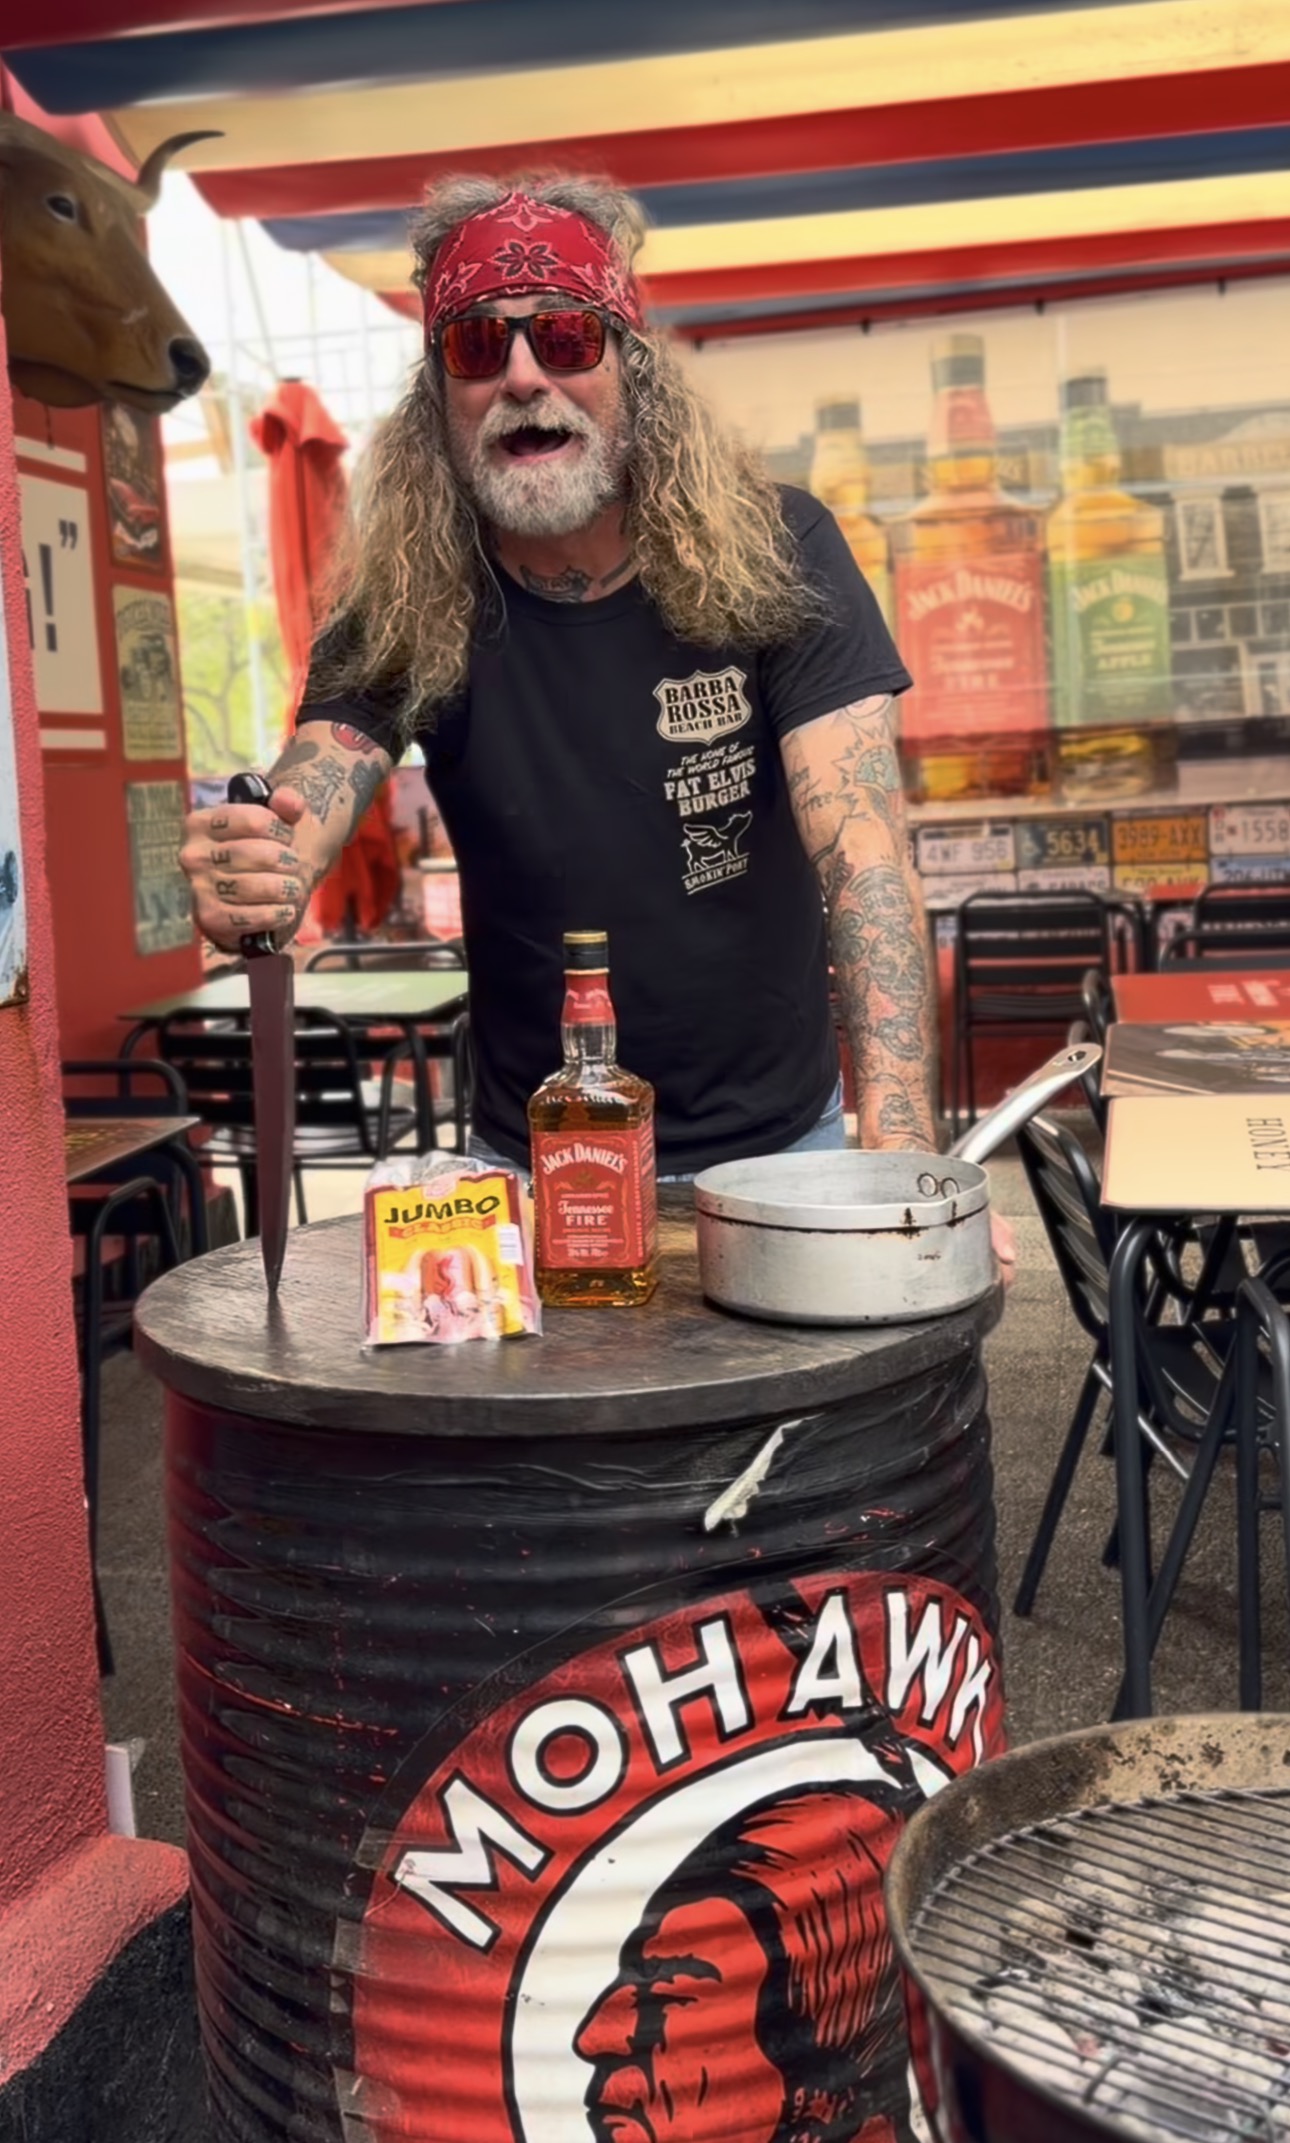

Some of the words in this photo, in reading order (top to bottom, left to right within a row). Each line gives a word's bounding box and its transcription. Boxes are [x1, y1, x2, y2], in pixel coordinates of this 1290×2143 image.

[664, 676, 737, 705] BARBA
[667, 693, 741, 724] ROSSA
[669, 719, 712, 735] BEACH
[717, 712, 742, 727] BAR
[667, 766, 684, 778] THE
[687, 759, 720, 774] WORLD
[721, 745, 755, 766] FAMOUS
[681, 753, 699, 766] THE
[700, 746, 727, 761] HOME
[728, 741, 740, 754] OF
[664, 776, 702, 801] FAT
[707, 757, 756, 791] ELVIS
[678, 780, 751, 817] BURGER
[540, 1144, 574, 1176] JACK
[573, 1142, 628, 1176] DANIEL'S
[1246, 1117, 1290, 1172] HONEY
[384, 1195, 501, 1224] JUMBO
[557, 1200, 615, 1216] Tennessee
[565, 1214, 608, 1227] FIRE
[394, 1590, 993, 1952] MOHAWK
